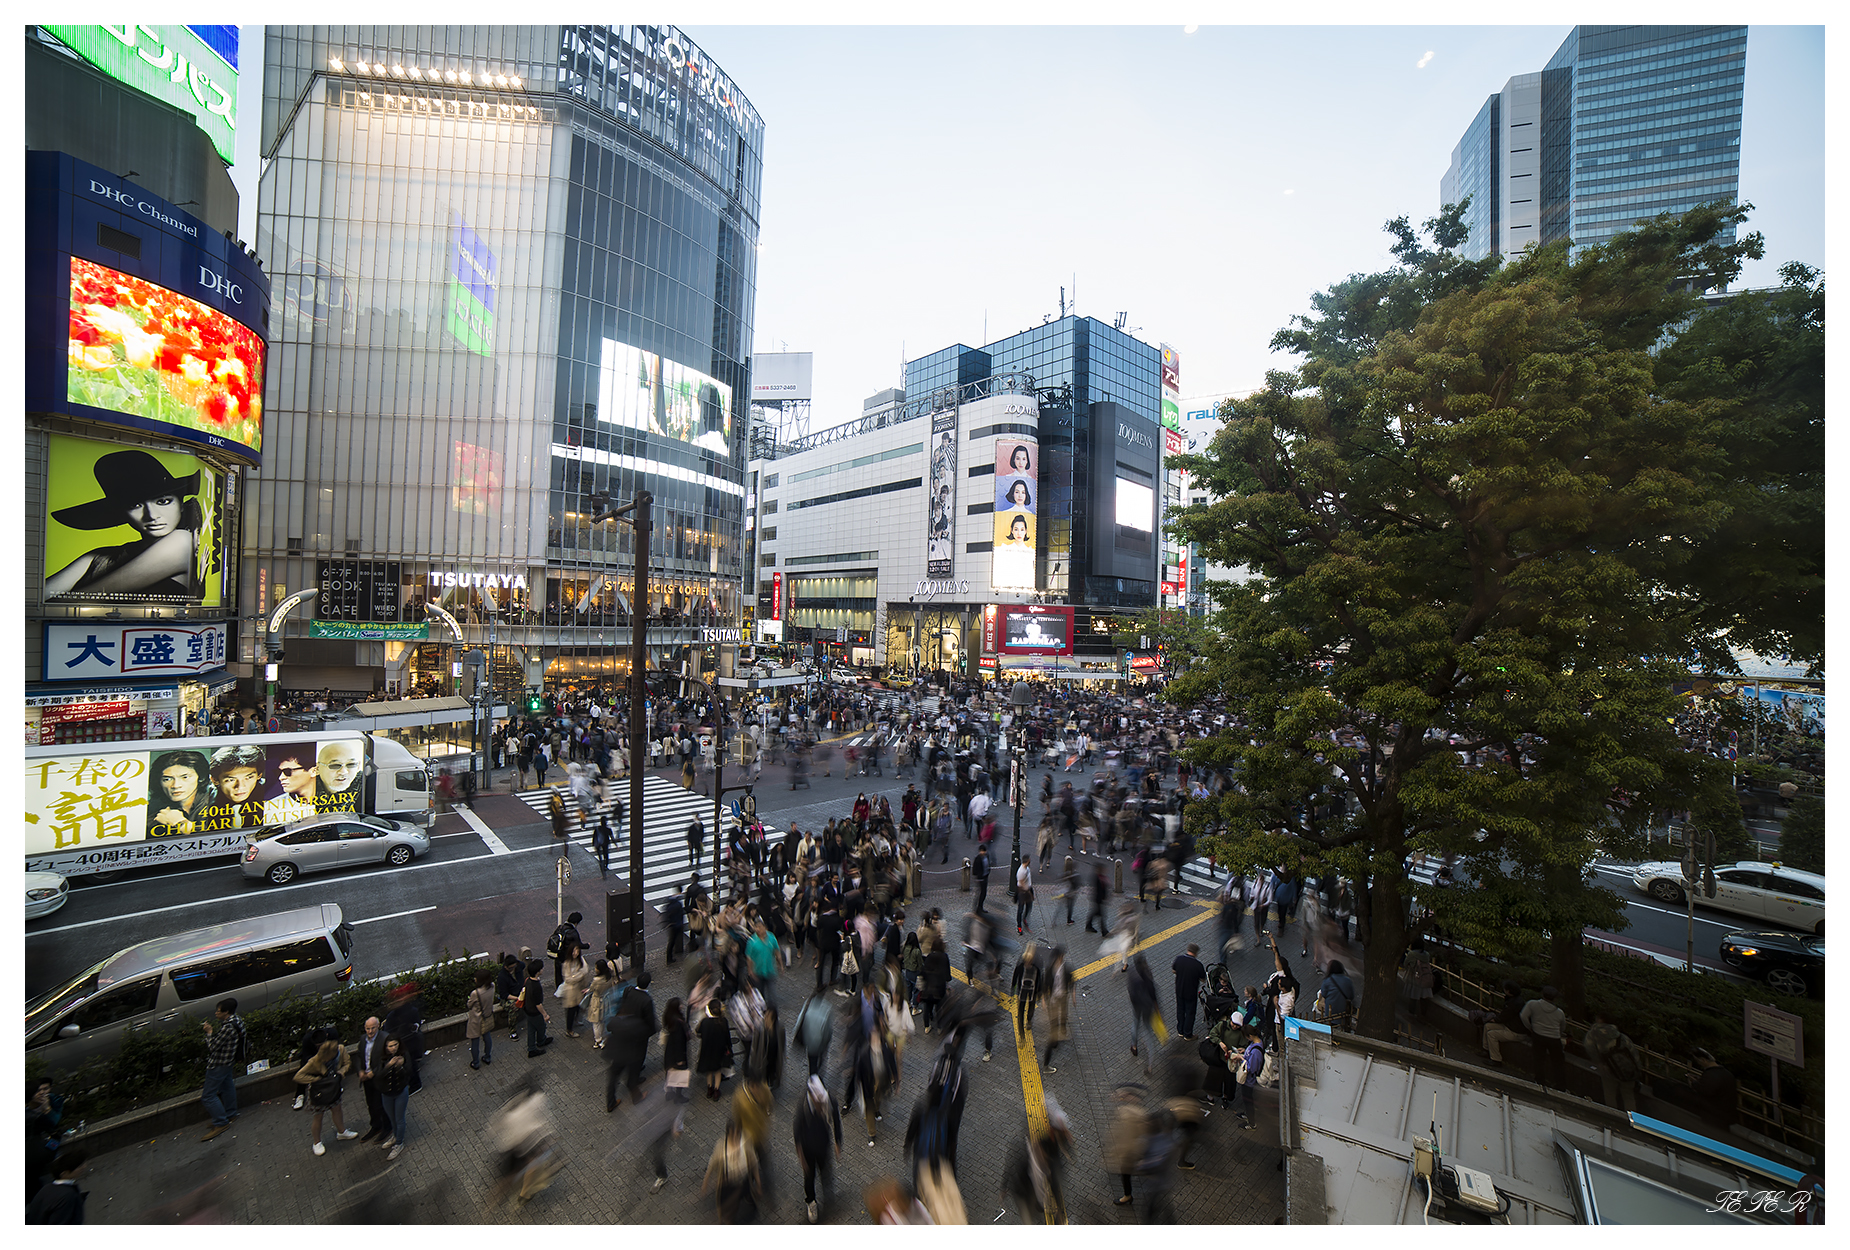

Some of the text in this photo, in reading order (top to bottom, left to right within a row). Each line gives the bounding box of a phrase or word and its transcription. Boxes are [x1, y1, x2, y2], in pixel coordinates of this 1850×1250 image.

[90, 179, 198, 237] DHC Channel
[199, 265, 243, 305] DHC
[208, 435, 226, 448] DHC
[321, 580, 363, 592] BOOK
[430, 571, 527, 589] TSUTAYA
[604, 580, 674, 595] STARUCKS
[321, 592, 329, 603] &
[702, 628, 741, 642] TSUTAYA
[64, 630, 224, 669] 大盛堂書店
[81, 686, 134, 694] TAISEIDO
[25, 757, 146, 790] 千春の
[25, 780, 149, 849] 譜
[198, 791, 358, 818] 40th ANNIVERSARY
[150, 804, 356, 838] CHIHARU MATSUYAMA
